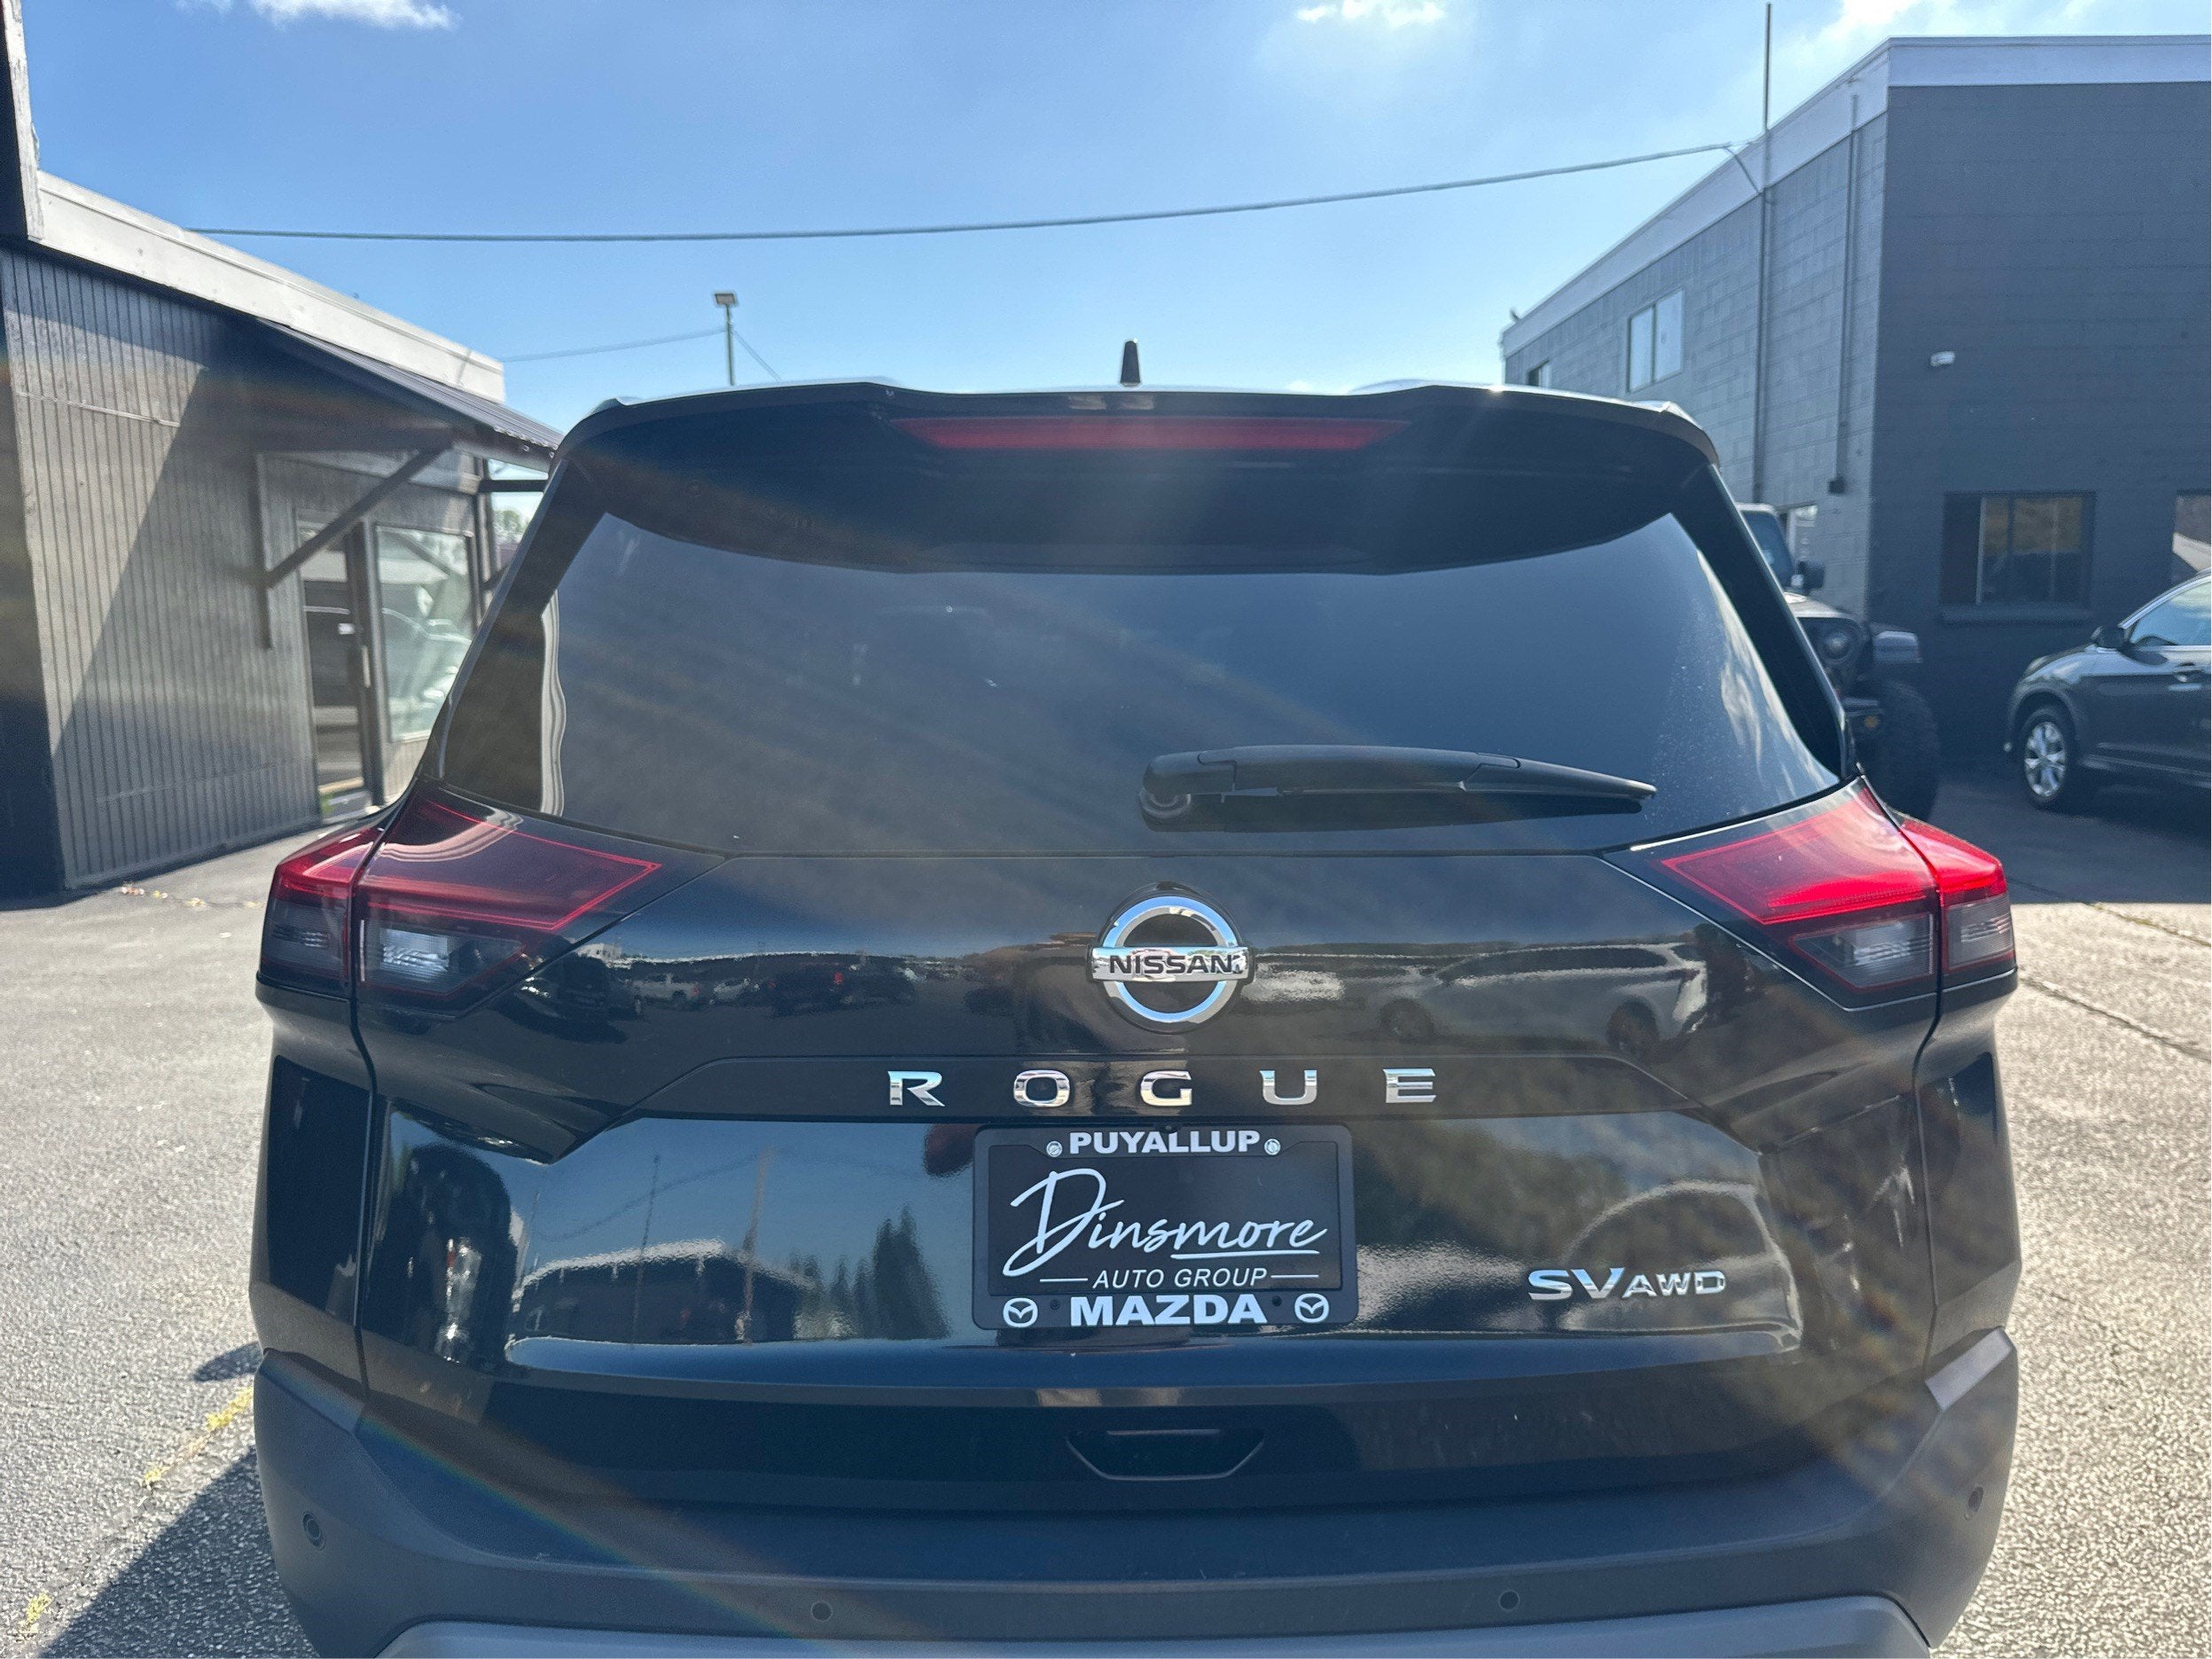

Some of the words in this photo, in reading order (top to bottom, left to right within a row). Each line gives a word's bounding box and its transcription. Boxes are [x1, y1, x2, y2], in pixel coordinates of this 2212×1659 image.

[1109, 954, 1232, 974] NISSAN
[887, 1068, 1437, 1107] ROGUE
[1069, 1130, 1261, 1154] PUYALLUP
[1002, 1167, 1329, 1278] Dinsmore
[1091, 1268, 1165, 1289] AUTO
[1174, 1267, 1268, 1287] GROUP
[1528, 1267, 1626, 1301] SV
[1622, 1270, 1727, 1299] AWD
[1070, 1293, 1268, 1327] MAZDA
